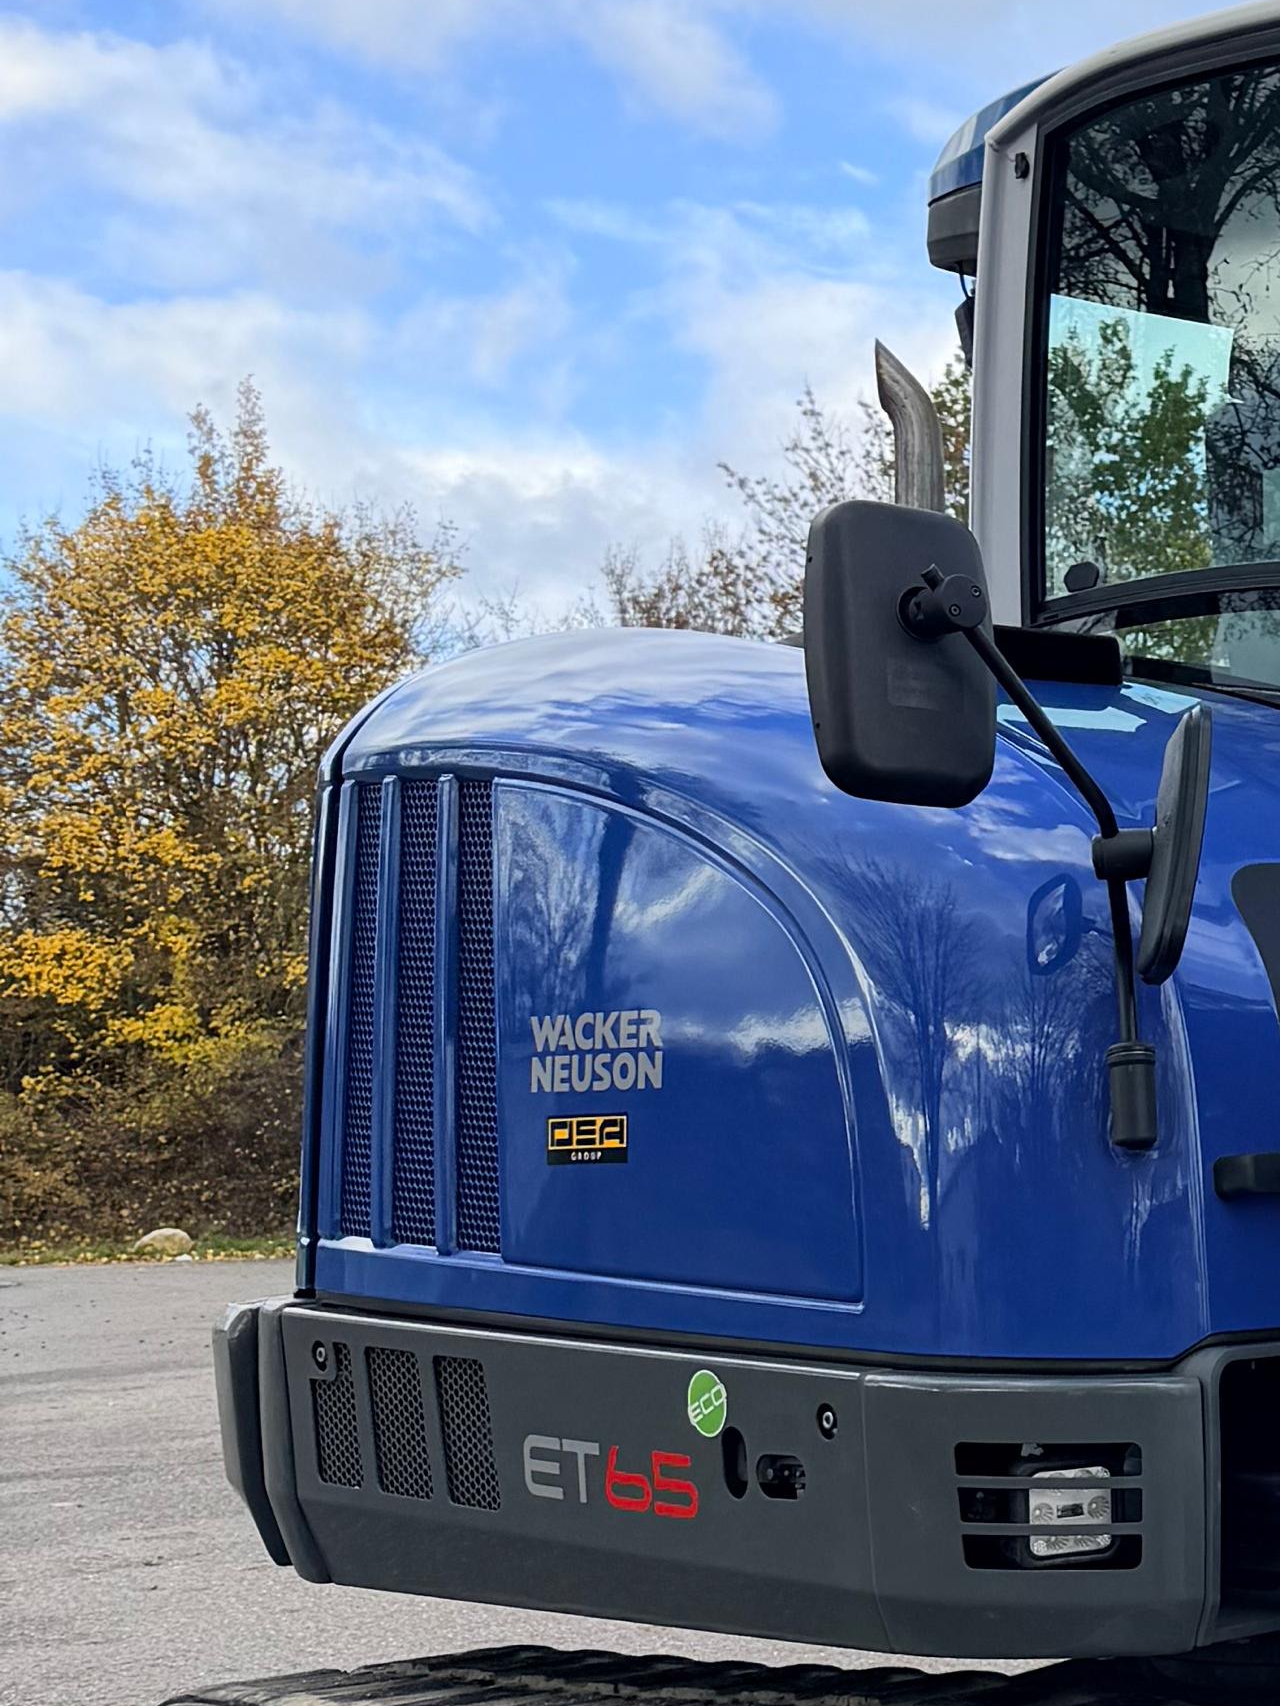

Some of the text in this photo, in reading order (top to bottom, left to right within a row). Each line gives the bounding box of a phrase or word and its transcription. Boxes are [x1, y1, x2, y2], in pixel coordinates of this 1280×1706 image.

[531, 1009, 663, 1053] WACKER
[531, 1051, 663, 1093] NEUSON
[688, 1383, 727, 1425] ECO
